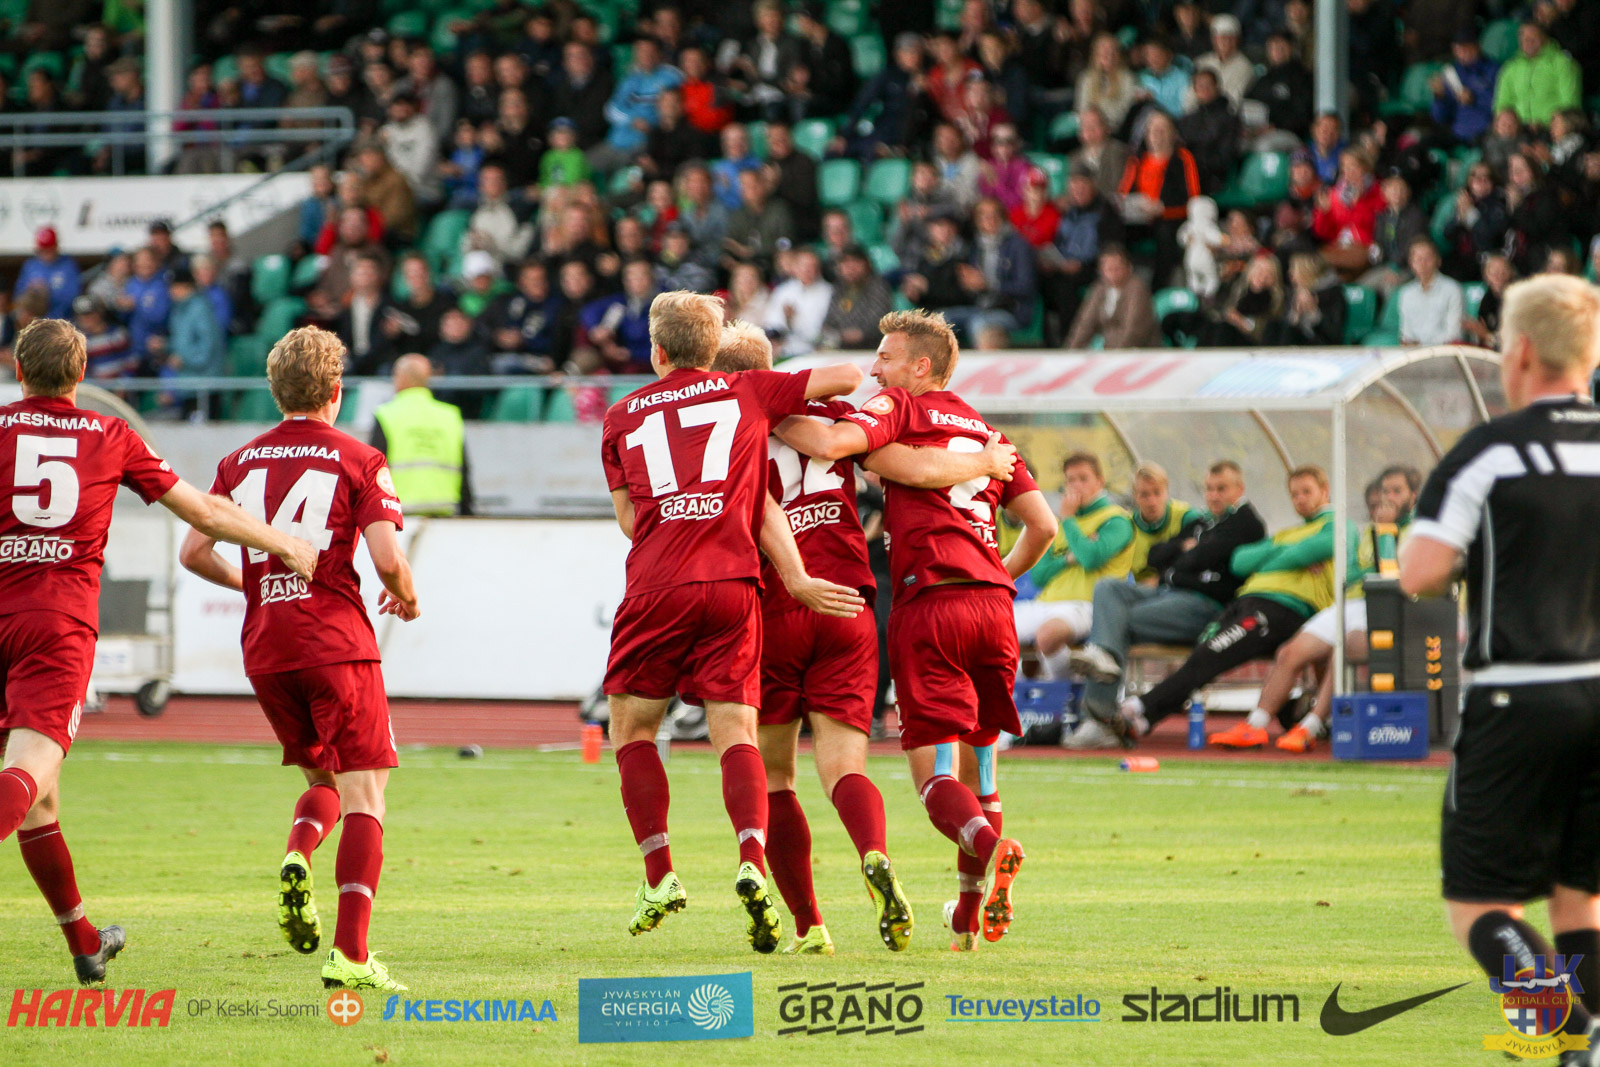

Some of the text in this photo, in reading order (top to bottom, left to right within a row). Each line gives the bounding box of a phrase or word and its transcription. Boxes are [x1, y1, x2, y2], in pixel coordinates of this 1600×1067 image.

[640, 377, 730, 410] KESKIMAA
[6, 412, 104, 433] KESKIMAA
[247, 445, 341, 463] KESKIMAA
[625, 398, 742, 498] 17
[11, 434, 80, 528] 5
[229, 467, 340, 564] 14
[660, 498, 724, 519] GRANO
[789, 505, 841, 531] RANO
[0, 540, 73, 560] GRANO
